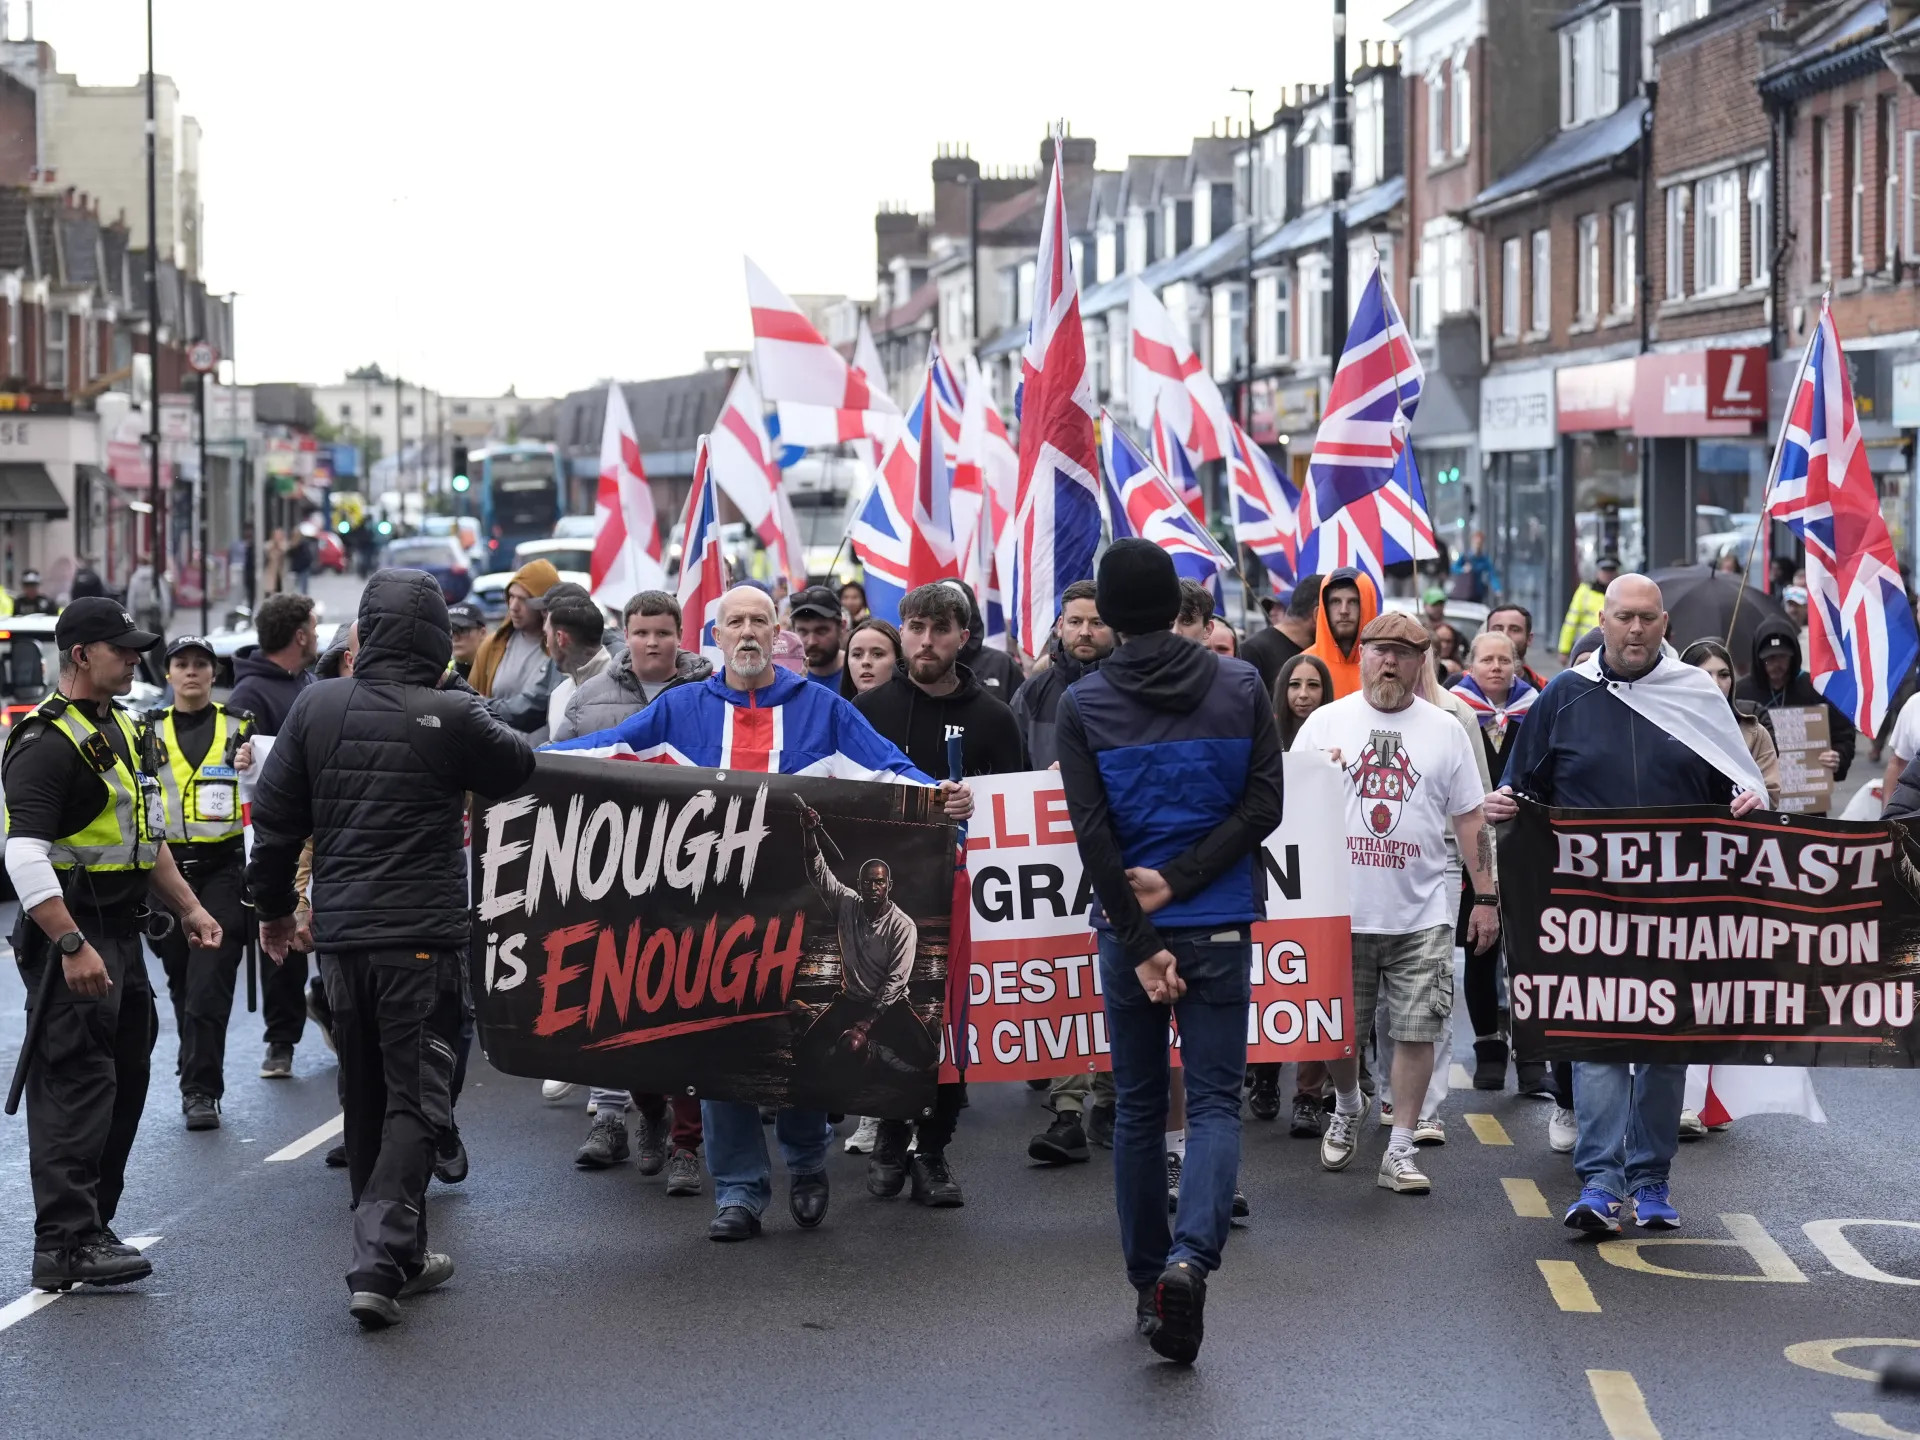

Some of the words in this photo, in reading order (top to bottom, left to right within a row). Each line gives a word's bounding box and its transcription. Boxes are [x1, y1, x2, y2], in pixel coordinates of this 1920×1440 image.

[1723, 354, 1752, 401] L
[179, 636, 206, 646] POLICE
[204, 767, 233, 776] POLICE
[211, 802, 223, 810] 2C
[212, 791, 225, 800] HC
[477, 781, 770, 921] ENOUGH
[1351, 851, 1406, 870] PATRIOTS
[1552, 830, 1893, 895] BELFAST
[1539, 908, 1880, 966] SOUTHAMPTON
[533, 910, 805, 1037] ENOUGH
[1513, 974, 1676, 1025] STANDS
[1691, 980, 1805, 1026] WITH
[1821, 981, 1915, 1027] YOU
